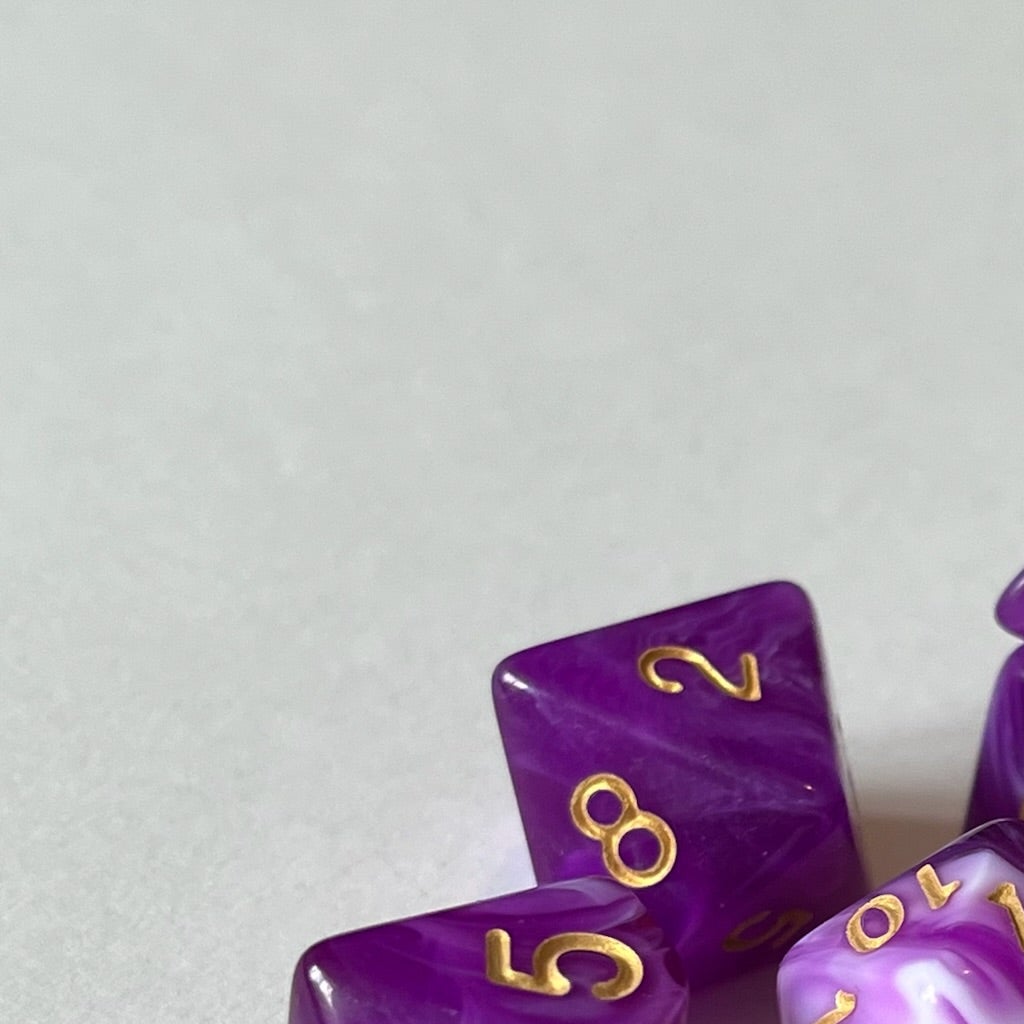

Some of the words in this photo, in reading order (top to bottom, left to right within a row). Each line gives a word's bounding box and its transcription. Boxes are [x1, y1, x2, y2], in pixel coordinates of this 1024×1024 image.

[638, 645, 762, 702] 2
[570, 772, 678, 888] 8
[846, 864, 961, 953] 10
[485, 928, 644, 1000] 5
